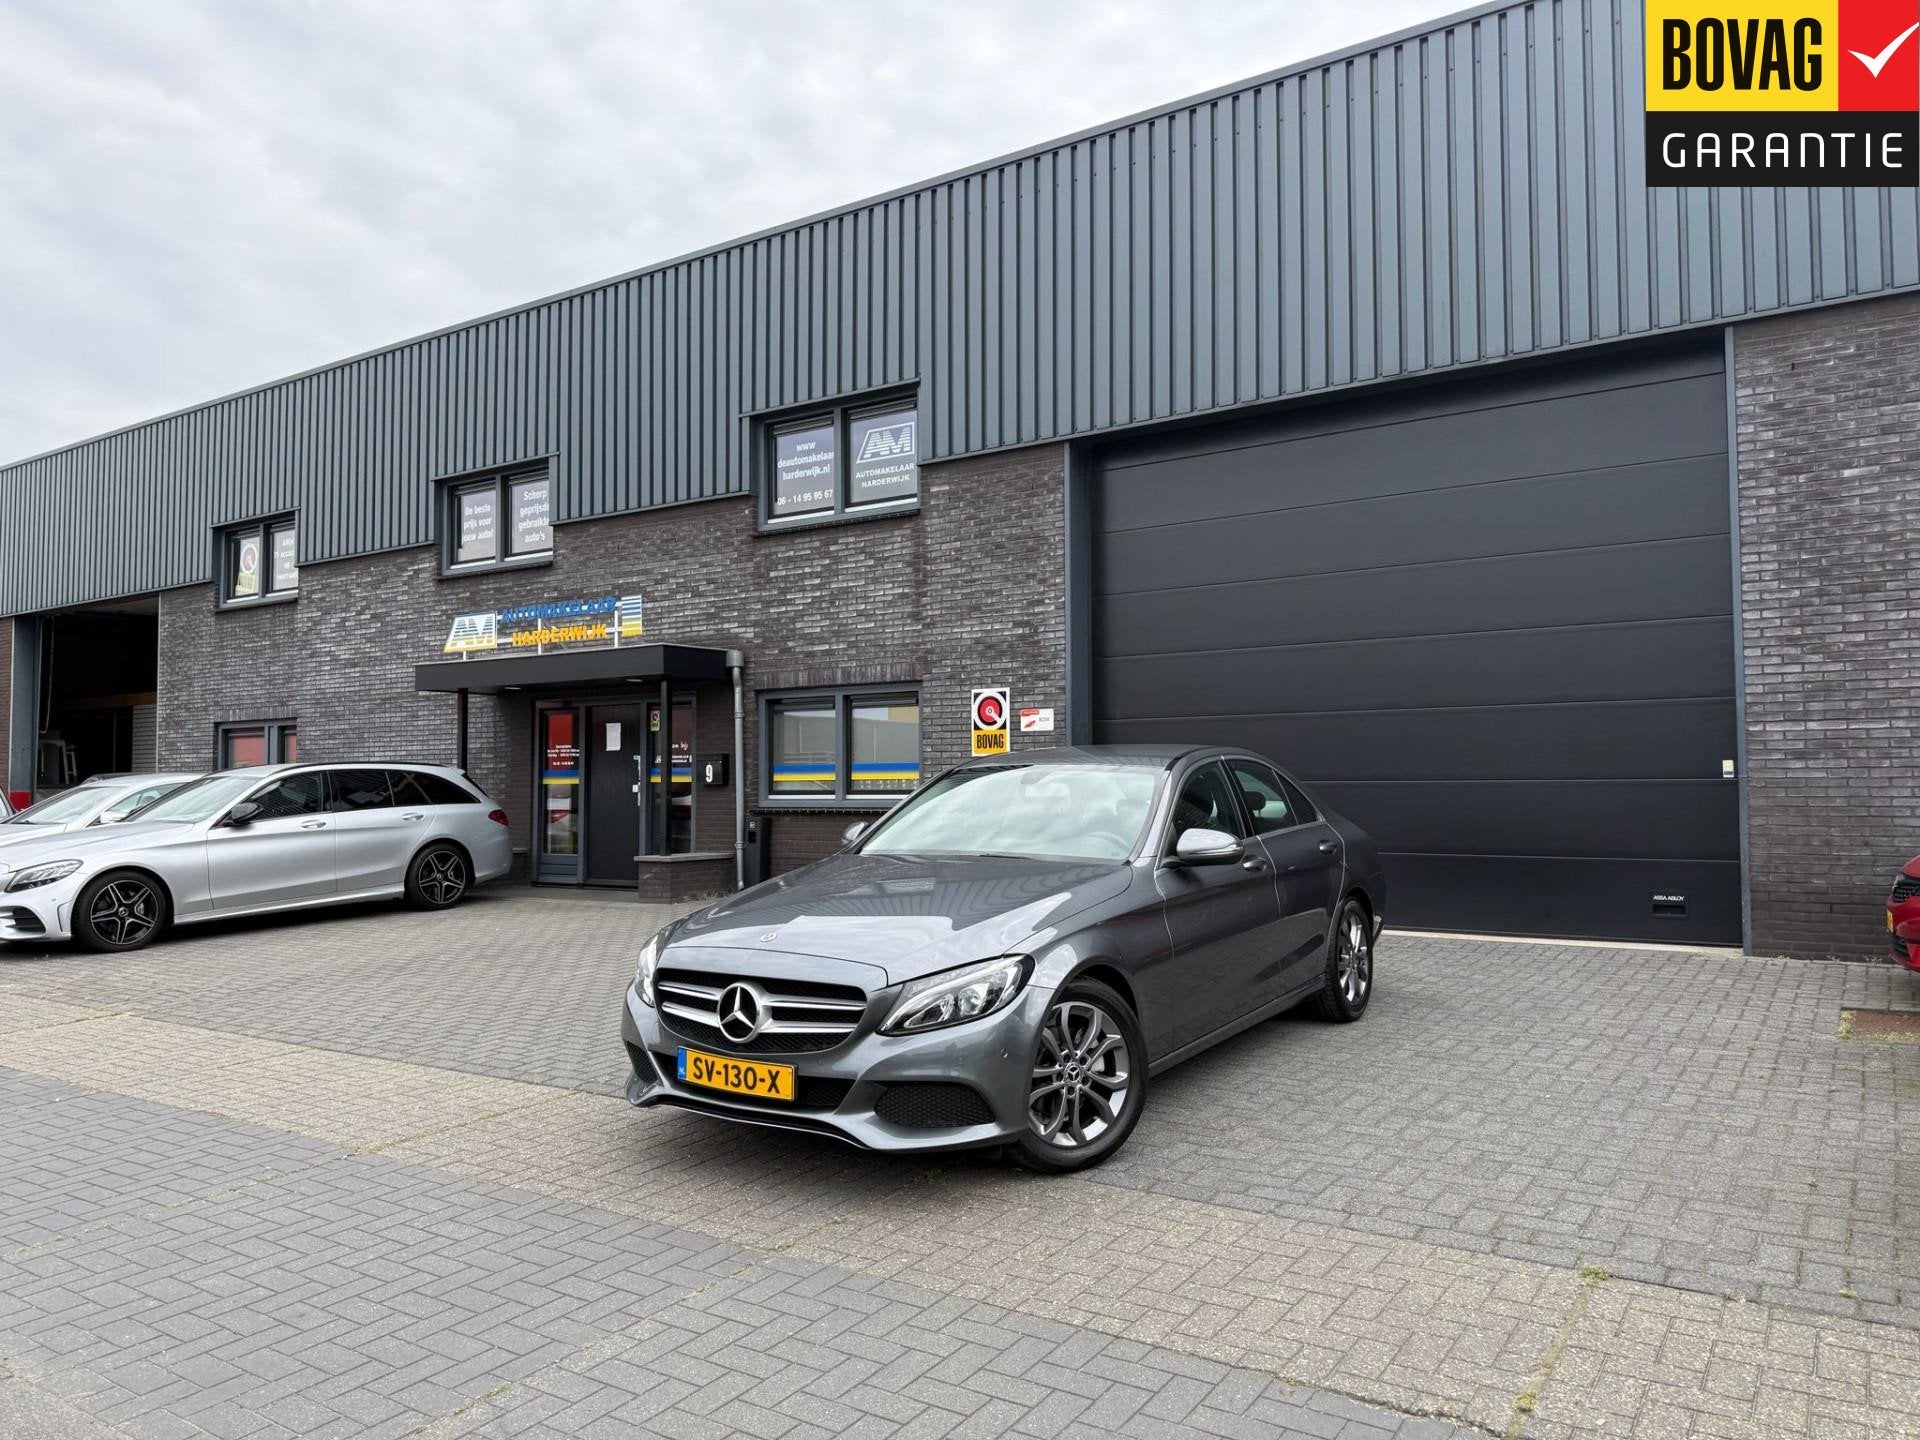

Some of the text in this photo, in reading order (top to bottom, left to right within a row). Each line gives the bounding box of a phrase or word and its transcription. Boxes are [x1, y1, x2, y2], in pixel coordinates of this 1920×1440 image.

[796, 441, 816, 452] www
[782, 463, 831, 481] harderwijk.nl
[856, 463, 915, 479] AUTOMAKELAAR
[861, 474, 910, 489] HARDERWIJK
[523, 490, 548, 501] Scherp
[793, 494, 802, 504] 14
[501, 595, 617, 623] AUTOMAKELAAR
[511, 623, 607, 646] HARDERWIJK
[976, 733, 1004, 749] BOVAG
[705, 764, 713, 783] 9
[693, 1057, 780, 1094] SV-130-X
